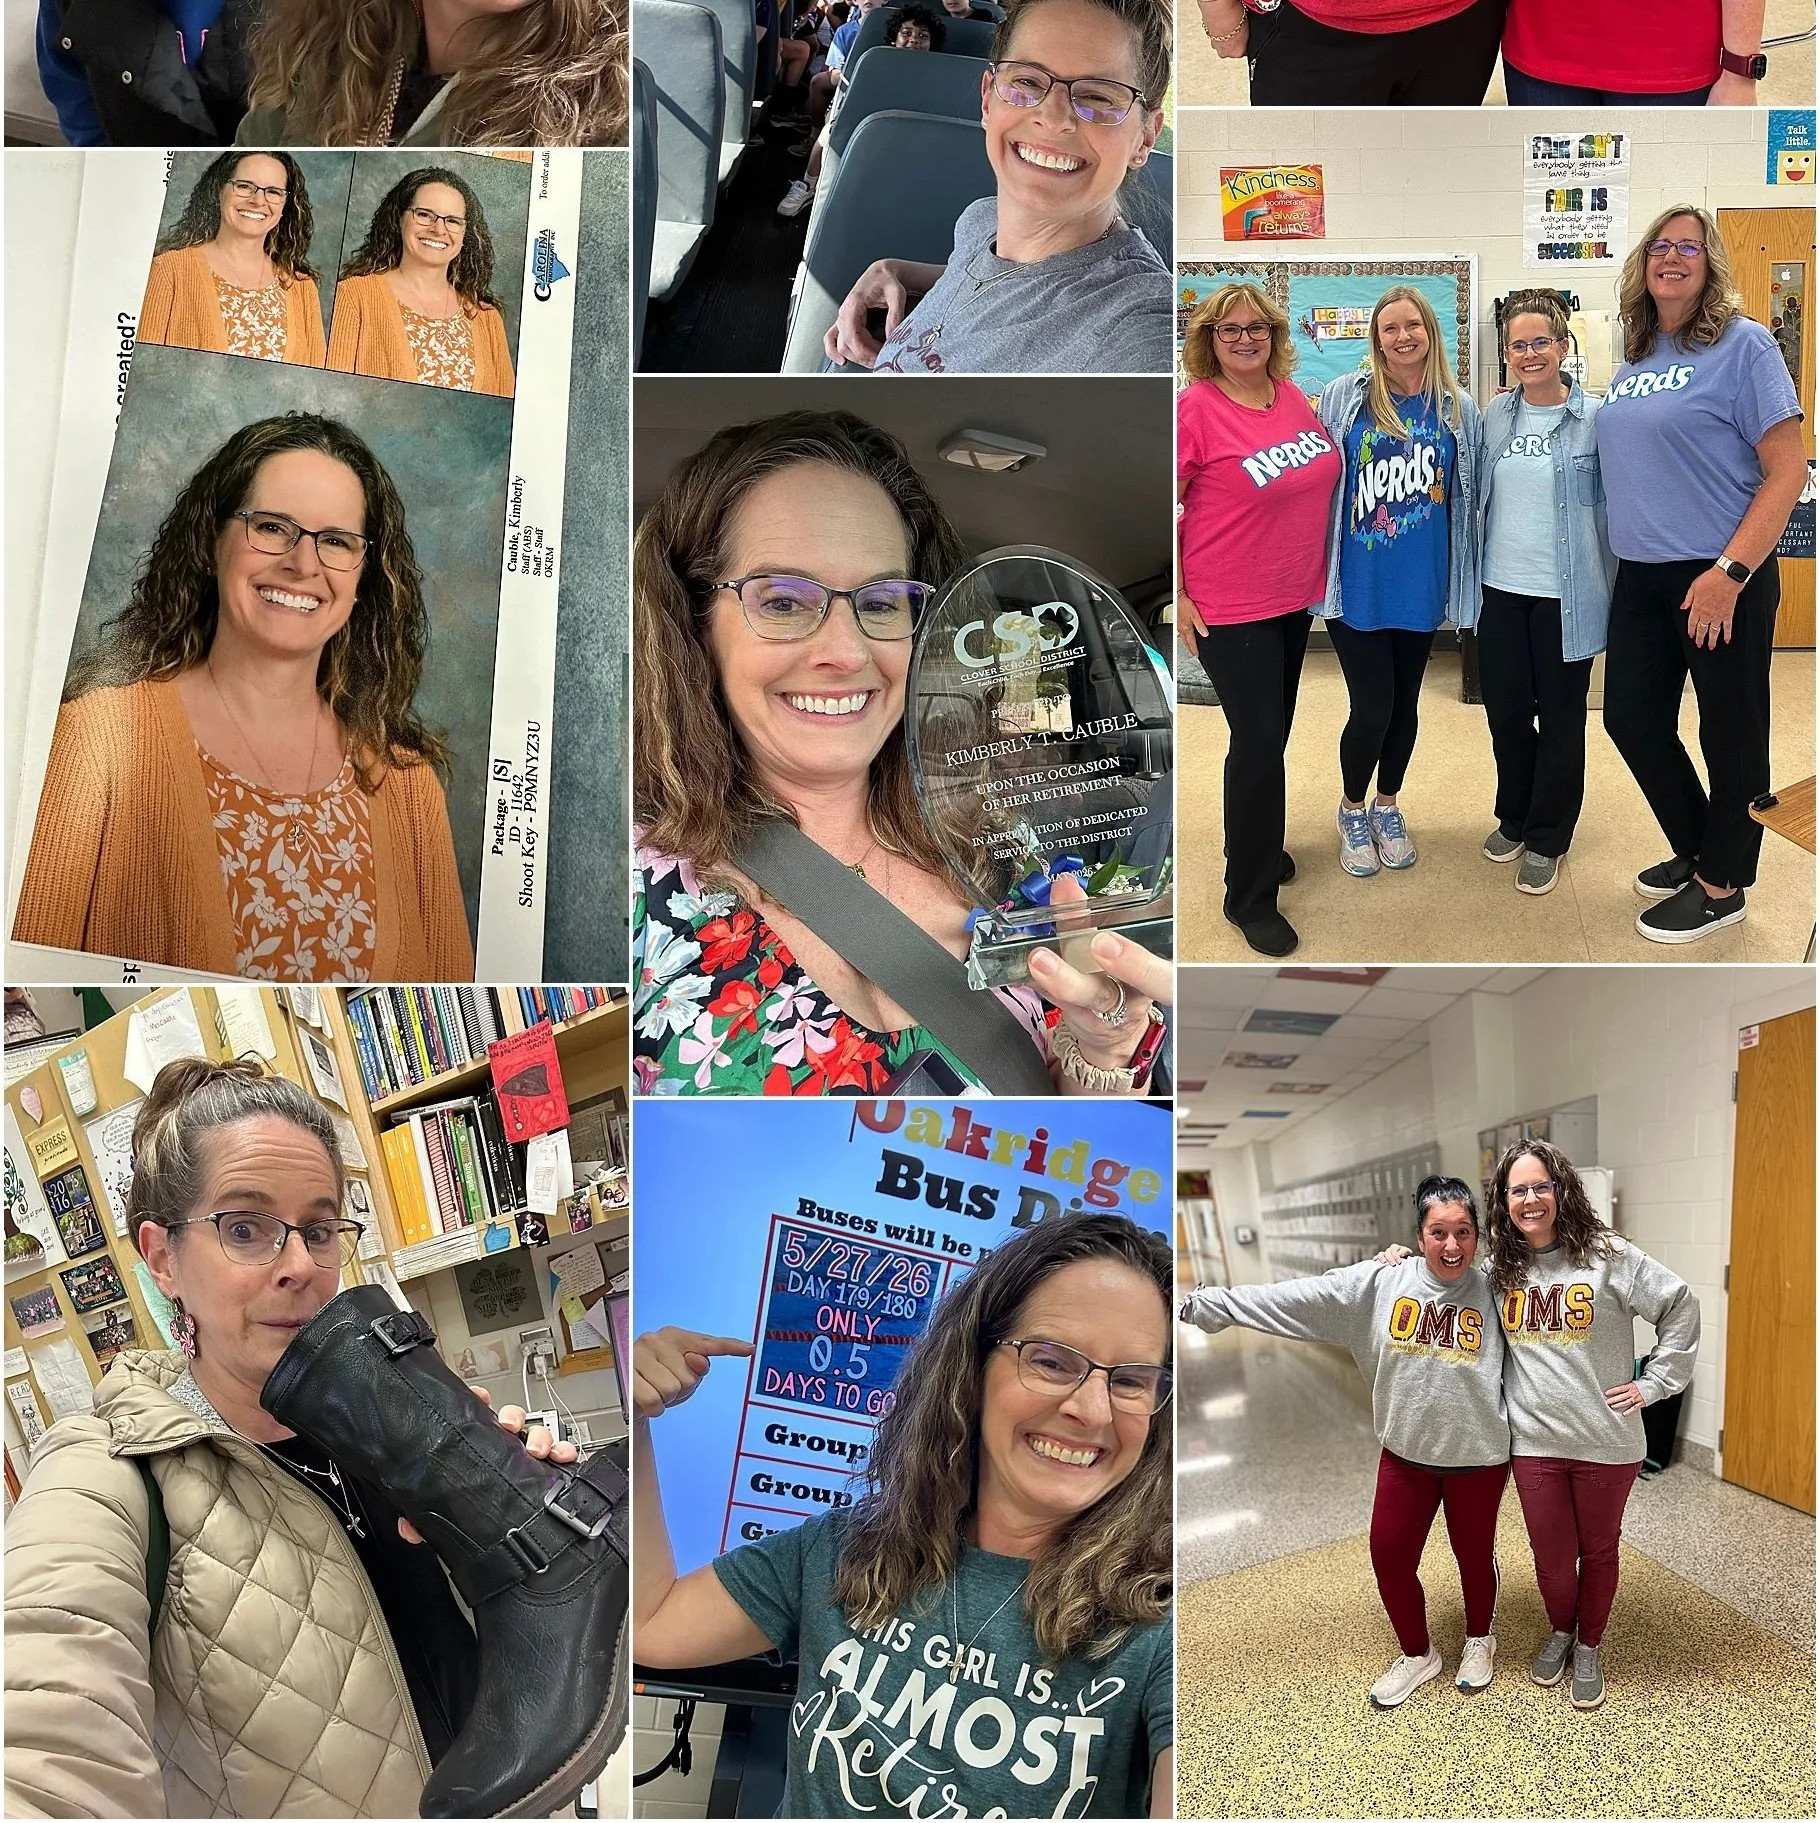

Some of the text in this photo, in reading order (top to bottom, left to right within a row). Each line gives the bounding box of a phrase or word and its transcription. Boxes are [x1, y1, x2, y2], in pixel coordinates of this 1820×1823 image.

[1785, 137, 1811, 146] little.
[1787, 126, 1807, 135] Talk
[1226, 171, 1320, 200] Kindness.
[1545, 188, 1608, 212] FAIR IS
[1318, 308, 1360, 323] Happy
[1321, 326, 1336, 337] To
[506, 475, 526, 573] Cauble, Kimberly
[533, 527, 544, 547] Staff
[521, 525, 534, 575] Staff (ABS)
[544, 546, 555, 578] OKRM
[960, 646, 1085, 682] CLOVER SCHOOL DISTRICT
[1043, 660, 1074, 672] Excellence
[945, 713, 1138, 767] KIMBERLY CAUBLE
[976, 757, 1121, 795] UPON THE OCCASION
[982, 775, 1122, 812] OF HER RETIREMENT
[509, 774, 524, 843] ID 11642
[972, 806, 1148, 847] IN OF DEDICATED
[491, 798, 509, 857] Package
[1056, 827, 1132, 849] THE DISTRICT
[518, 827, 539, 908] Shoot Key
[35, 1130, 67, 1156] EXPRESS
[51, 1179, 64, 1197] 20
[875, 1149, 999, 1220] Bus
[56, 1194, 71, 1213] 16
[796, 1198, 973, 1258] Buses will be
[783, 1230, 933, 1297] 5/27/26
[787, 1270, 831, 1300] DAY
[816, 1305, 881, 1341] ONLY
[1389, 1295, 1484, 1352] OMS
[1502, 1282, 1595, 1332] OMS
[10, 1383, 31, 1397] READ
[764, 1369, 861, 1409] DAYS TO
[820, 1638, 1105, 1790] ALMOST
